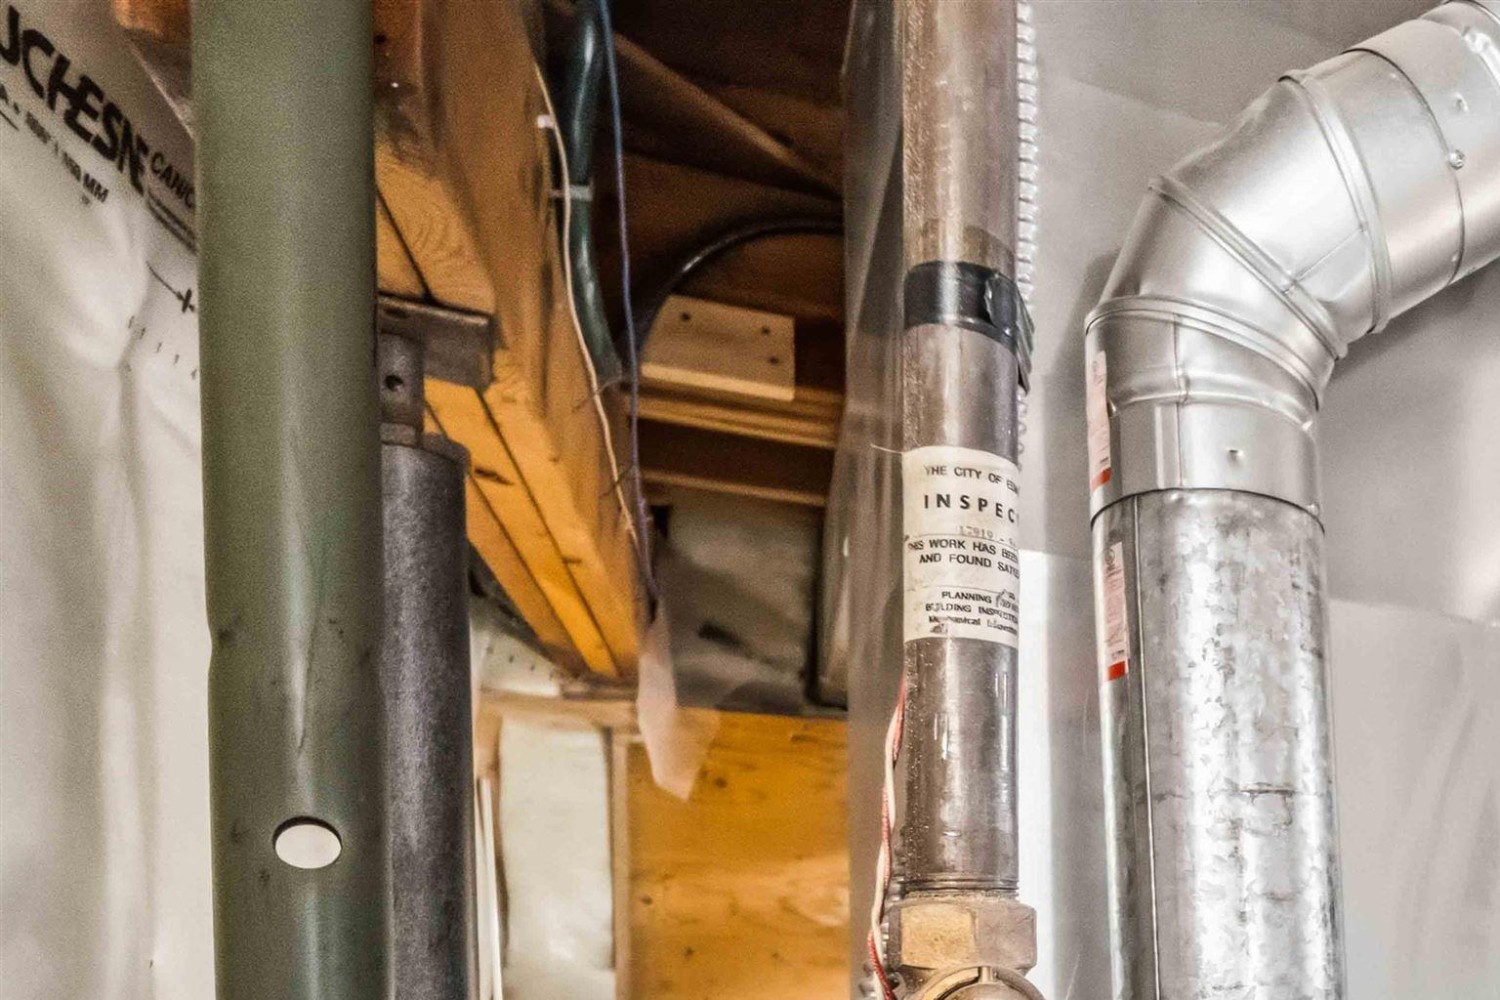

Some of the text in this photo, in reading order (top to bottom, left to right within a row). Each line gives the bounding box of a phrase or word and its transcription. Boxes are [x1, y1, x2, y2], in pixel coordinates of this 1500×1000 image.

[954, 467, 982, 479] CITY
[988, 473, 1002, 484] OF
[923, 493, 1019, 525] INSPEC
[929, 538, 967, 550] WORK
[972, 541, 997, 555] HAS
[919, 553, 942, 563] AND
[948, 553, 992, 568] FOUND
[941, 590, 992, 604] PLANNING
